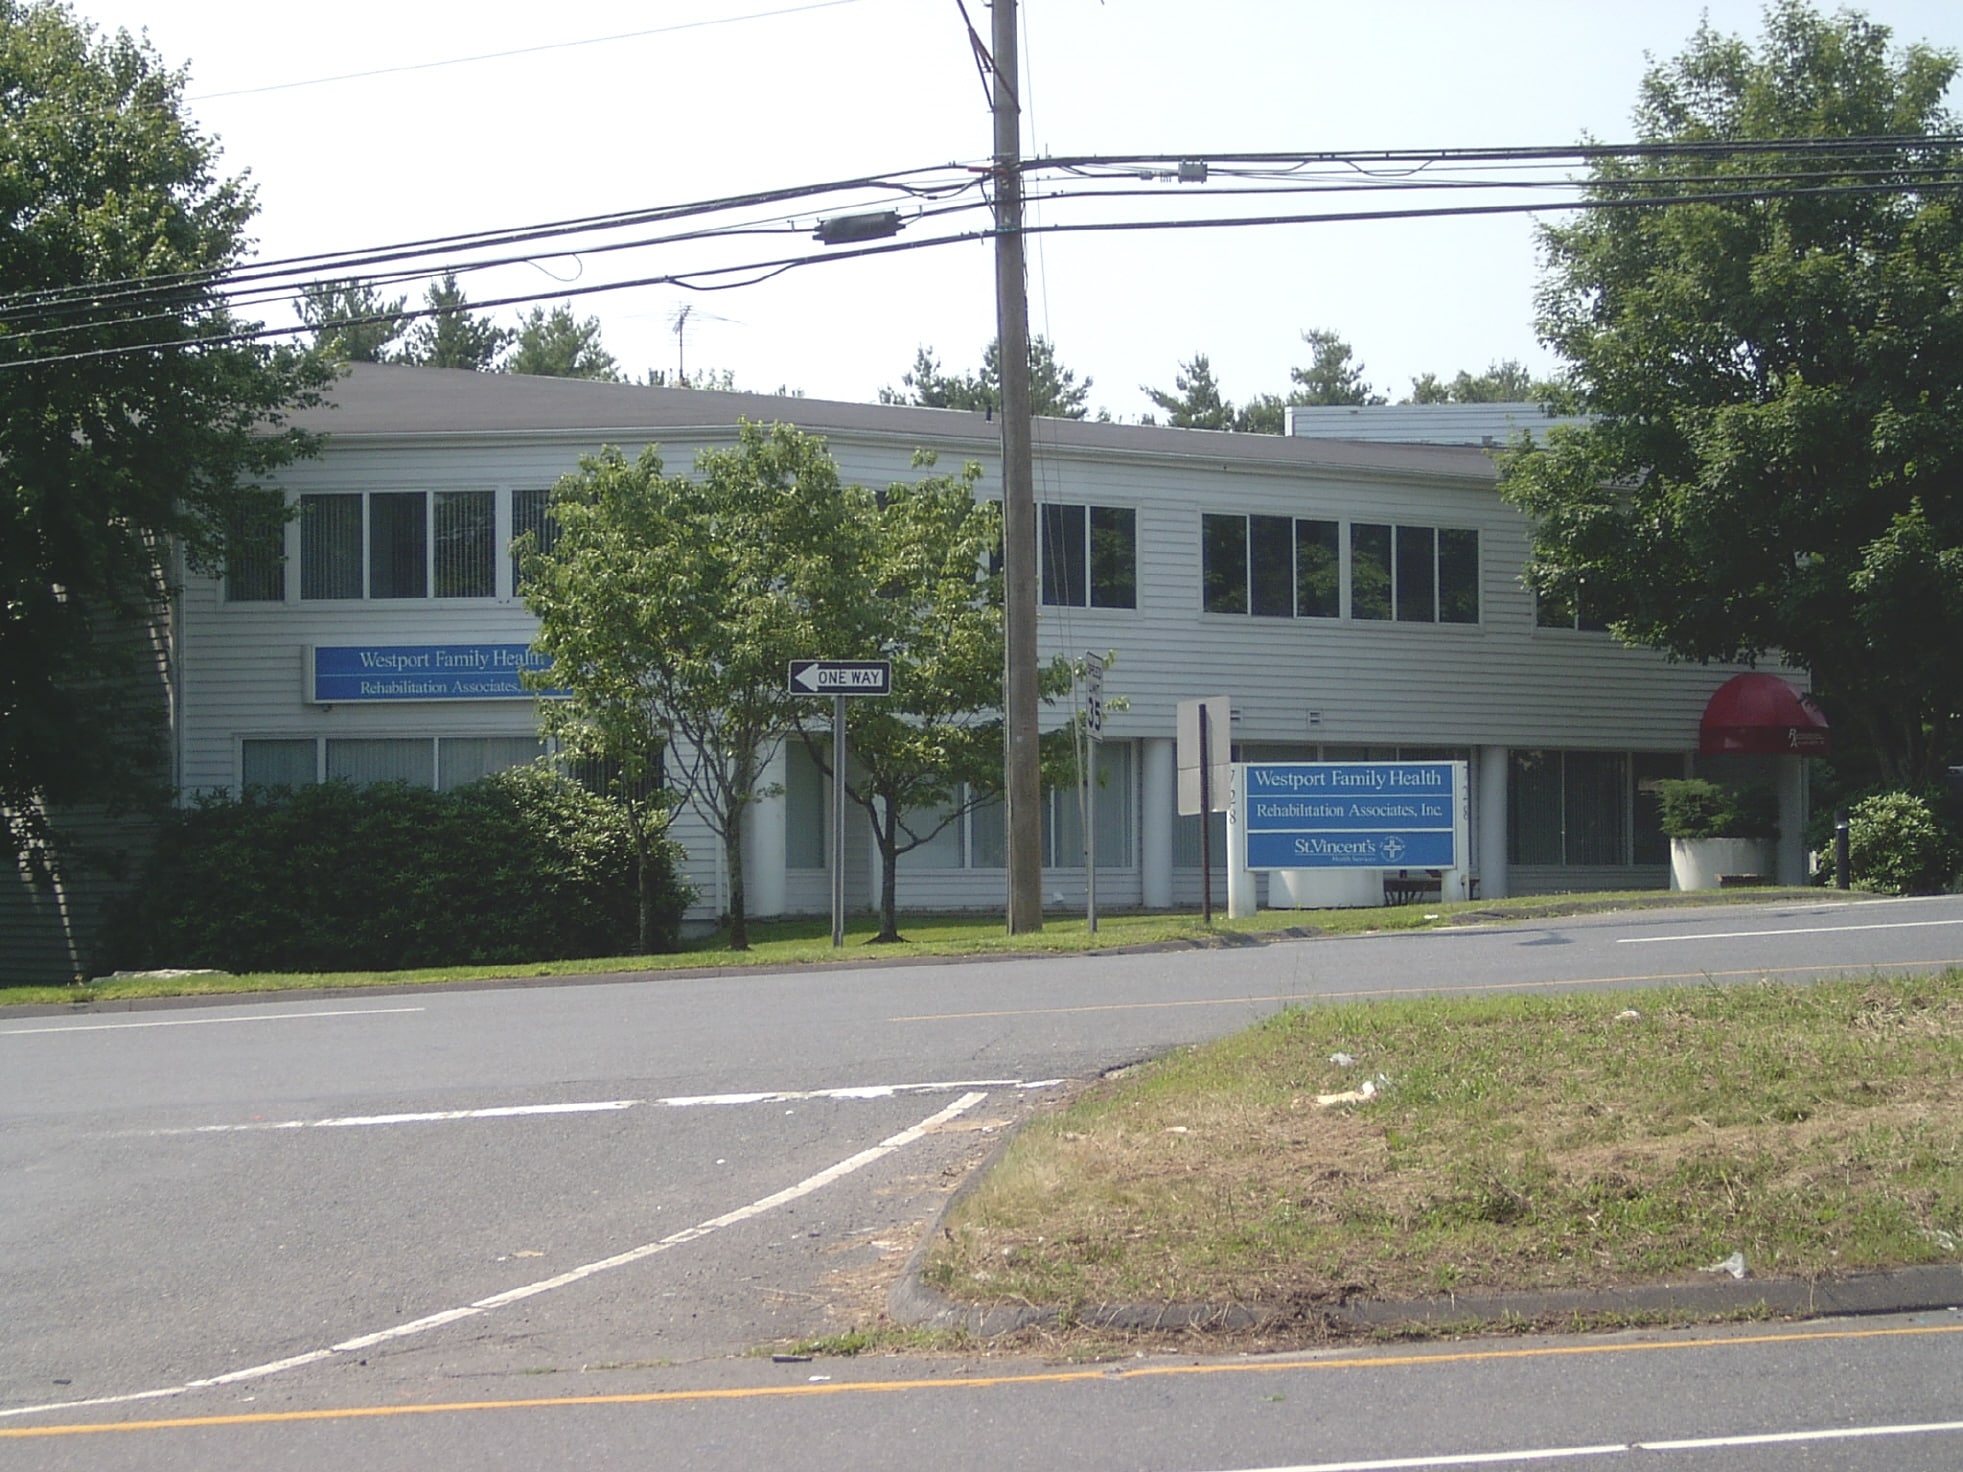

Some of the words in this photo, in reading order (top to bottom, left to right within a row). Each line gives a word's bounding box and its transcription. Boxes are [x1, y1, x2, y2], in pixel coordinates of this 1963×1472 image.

[360, 651, 430, 671] Westport
[435, 650, 489, 670] Family
[818, 671, 847, 685] ONE
[851, 671, 880, 685] WAY
[360, 680, 447, 695] Rehabilitation
[1088, 696, 1101, 732] 35
[1254, 770, 1326, 790] Westport
[1332, 770, 1386, 790] Family
[1389, 769, 1442, 787] Health
[1256, 803, 1344, 818] Rehabilitation
[1349, 803, 1418, 818] Associates,
[1421, 803, 1443, 817] Inc.
